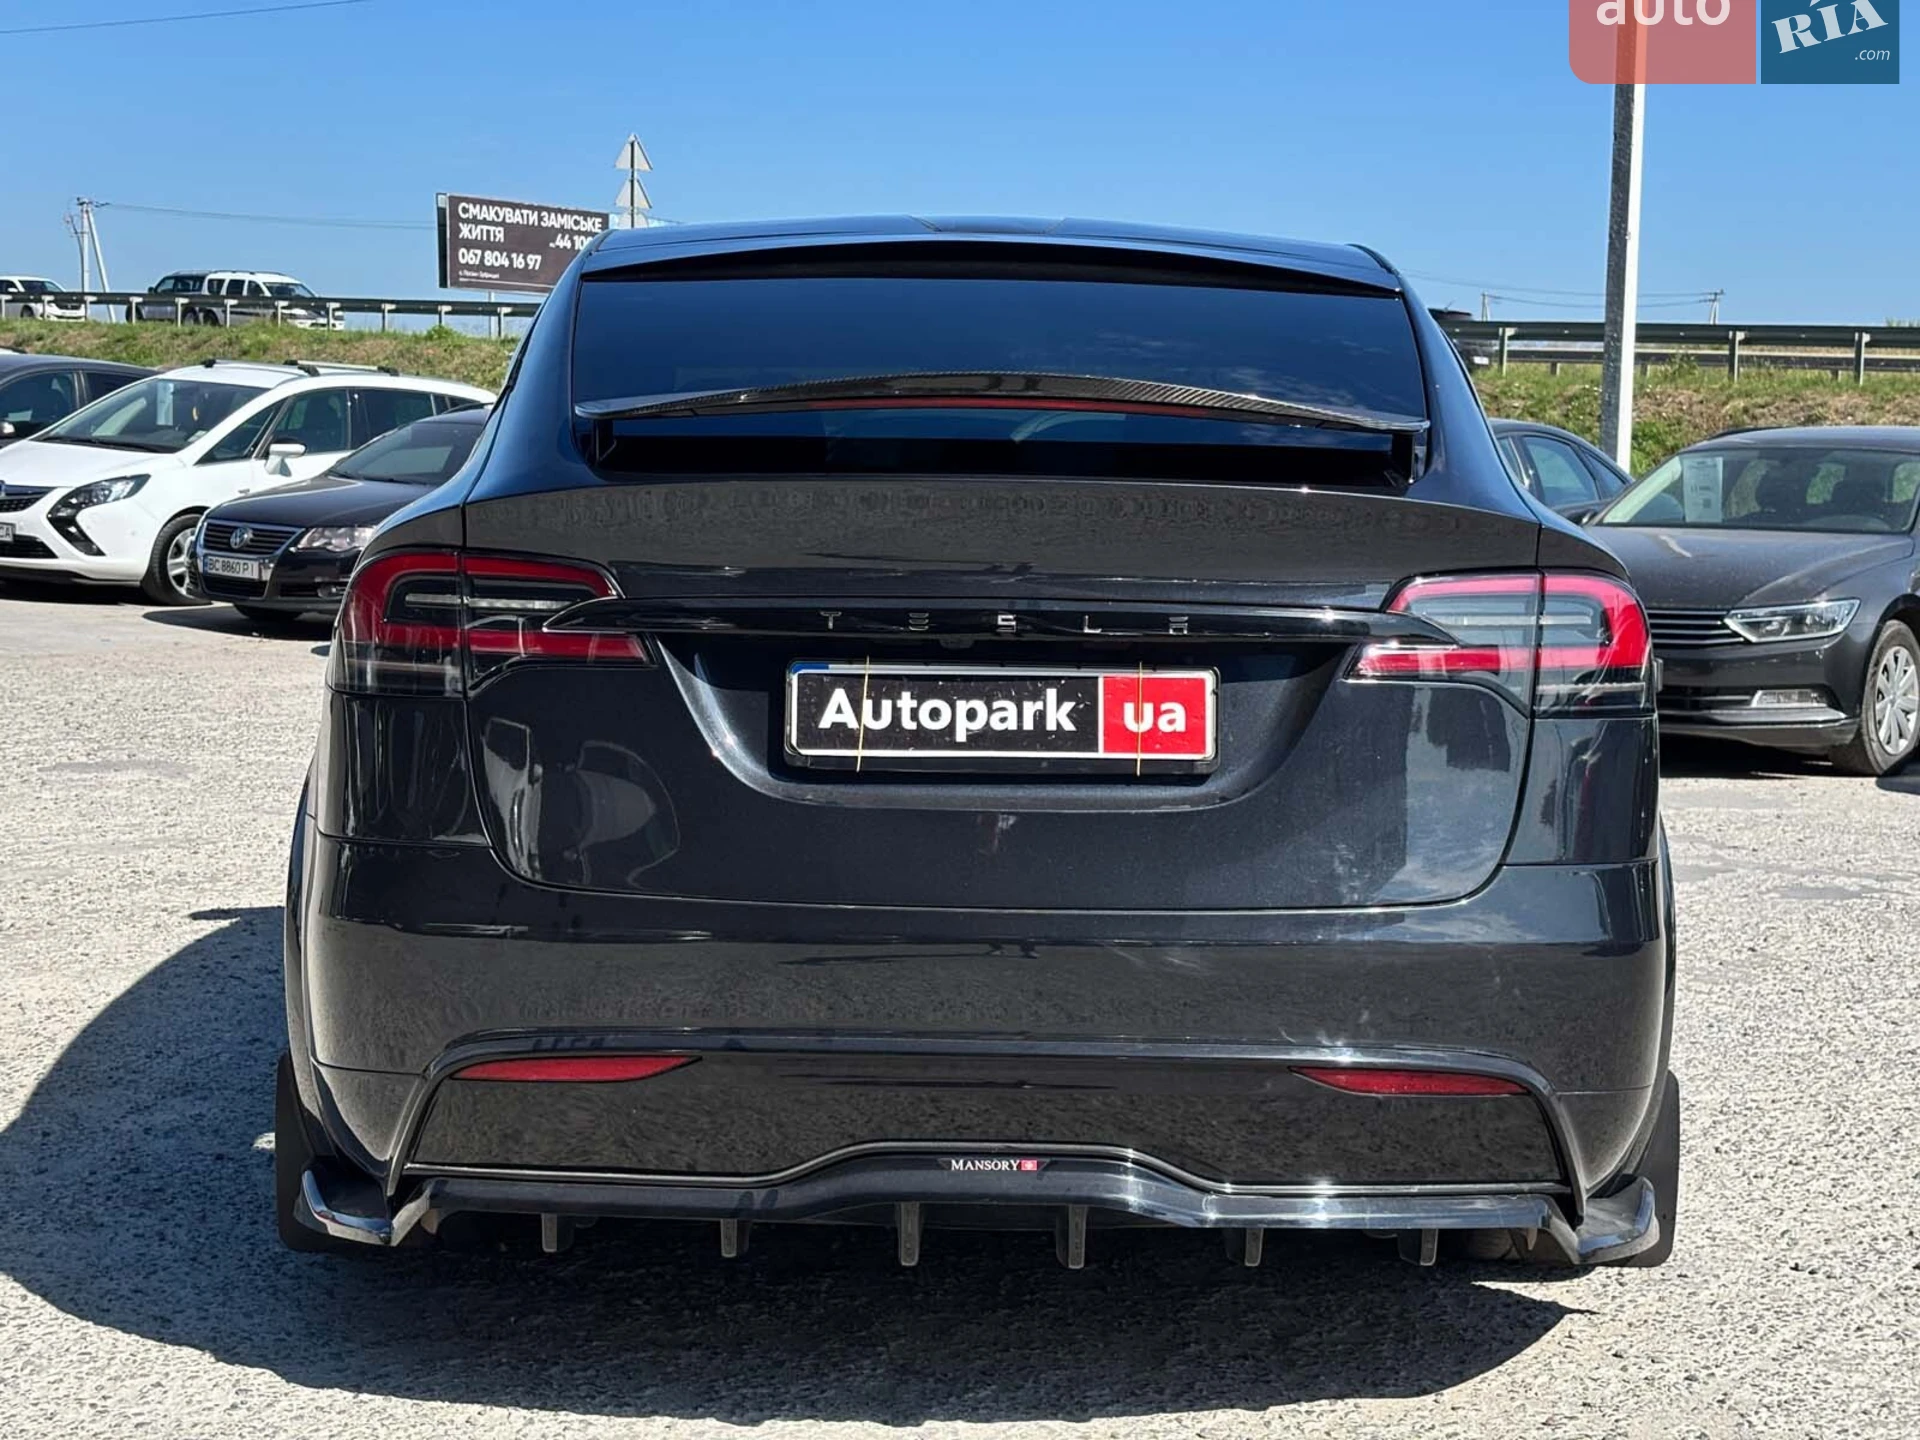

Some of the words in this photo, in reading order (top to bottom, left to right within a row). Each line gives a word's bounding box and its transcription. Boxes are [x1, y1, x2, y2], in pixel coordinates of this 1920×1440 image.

[458, 202, 538, 226] СМАКУВАТИ
[540, 211, 602, 233] ЗАМІСЬКЕ
[458, 222, 505, 243] ЖИТТЯ
[555, 233, 572, 249] 44
[458, 247, 482, 265] 067
[484, 250, 509, 268] 804
[511, 252, 525, 269] 16
[526, 254, 542, 270] 97
[820, 611, 1189, 635] TESLA
[818, 688, 1077, 742] Autopark
[1123, 701, 1187, 733] ua
